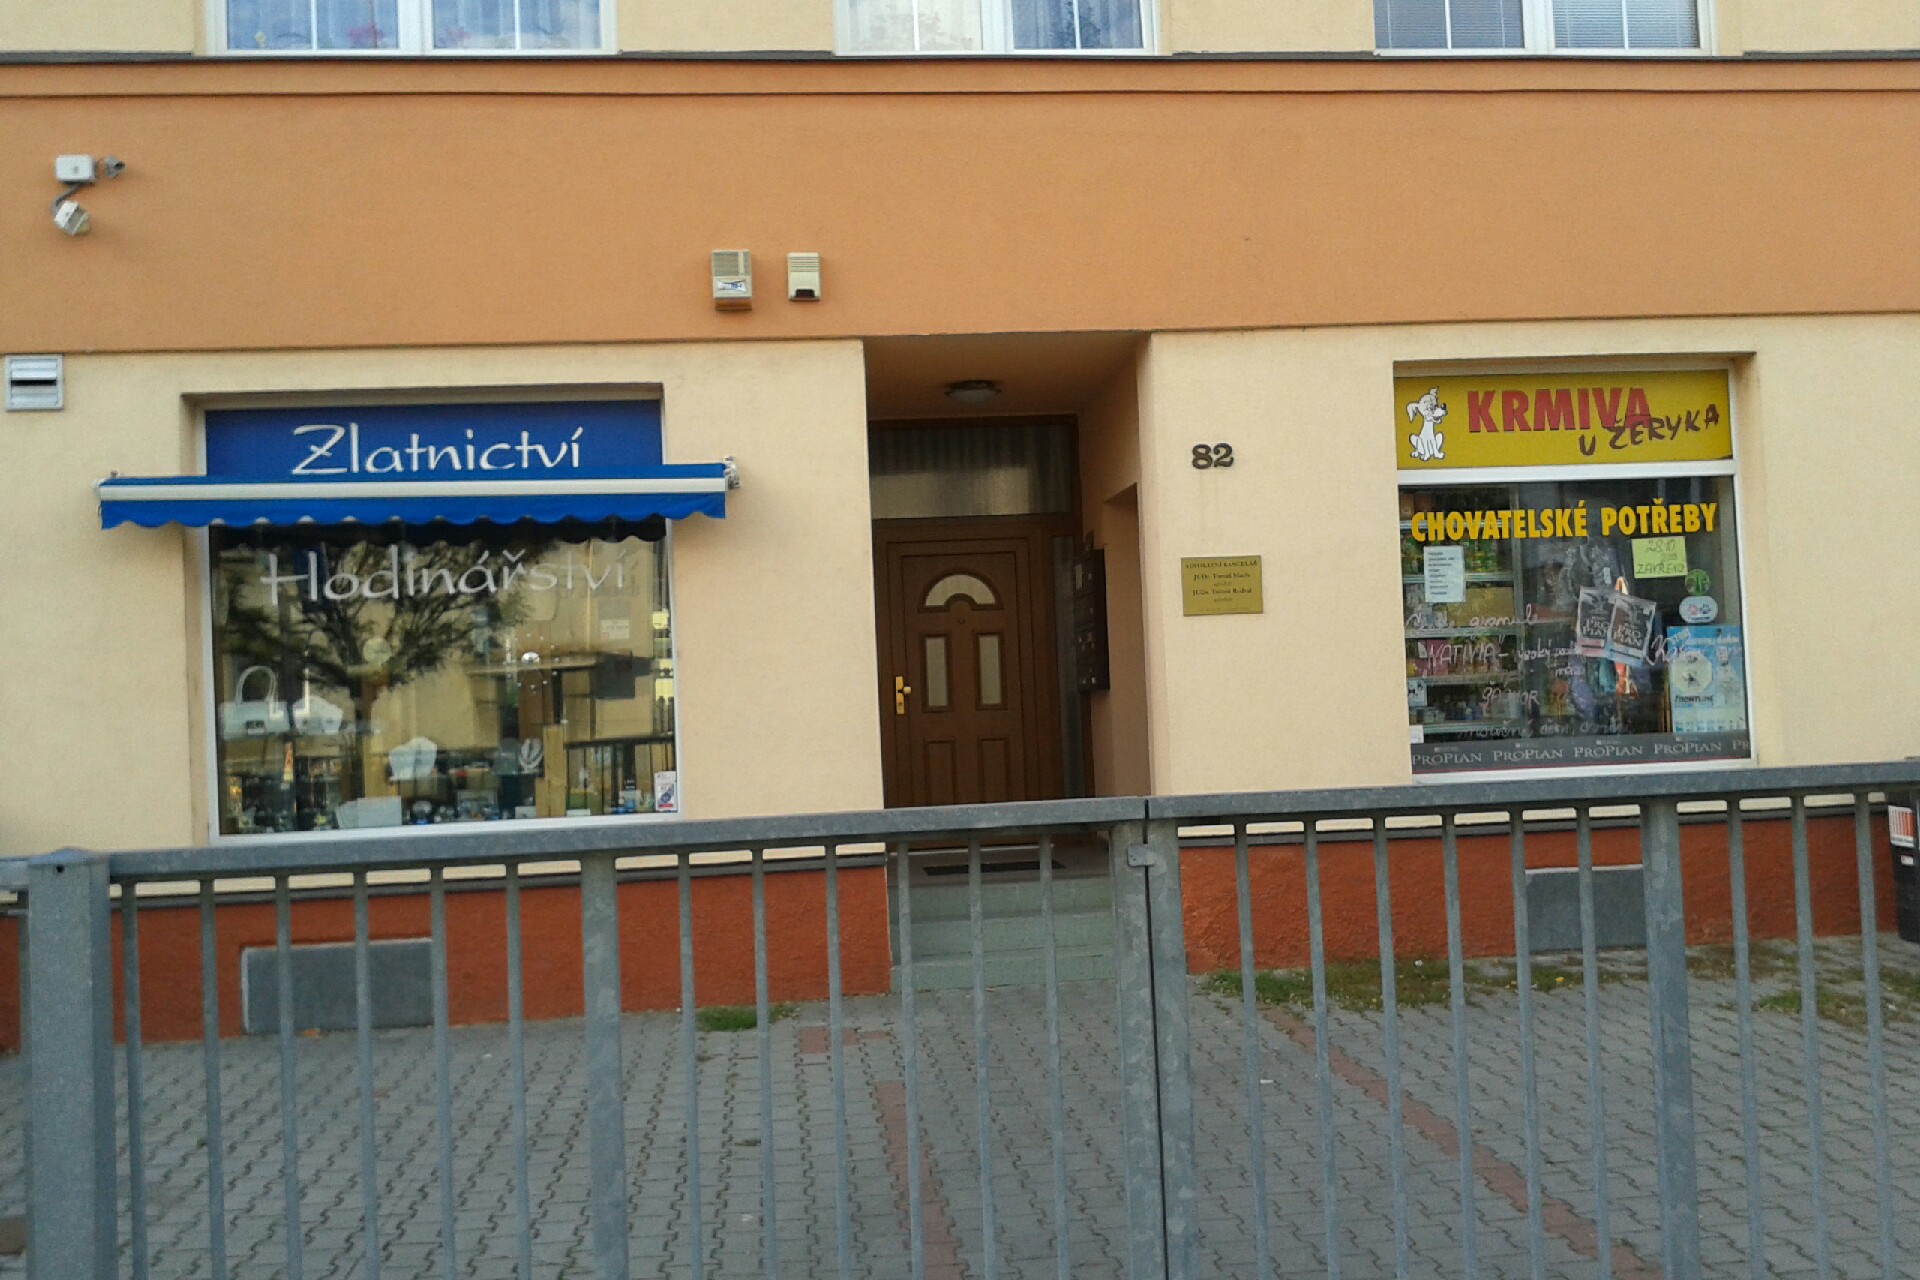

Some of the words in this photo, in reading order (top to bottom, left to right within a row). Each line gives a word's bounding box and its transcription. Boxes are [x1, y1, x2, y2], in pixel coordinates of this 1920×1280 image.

[1467, 387, 1651, 433] KRMIVA
[290, 422, 585, 476] Zlatnictví
[1191, 442, 1234, 470] 82
[1579, 434, 1596, 456] U
[1411, 500, 1588, 542] CHOVATELSKÉ
[1601, 497, 1718, 537] POTŘEBY
[260, 545, 627, 605] Hodinářství
